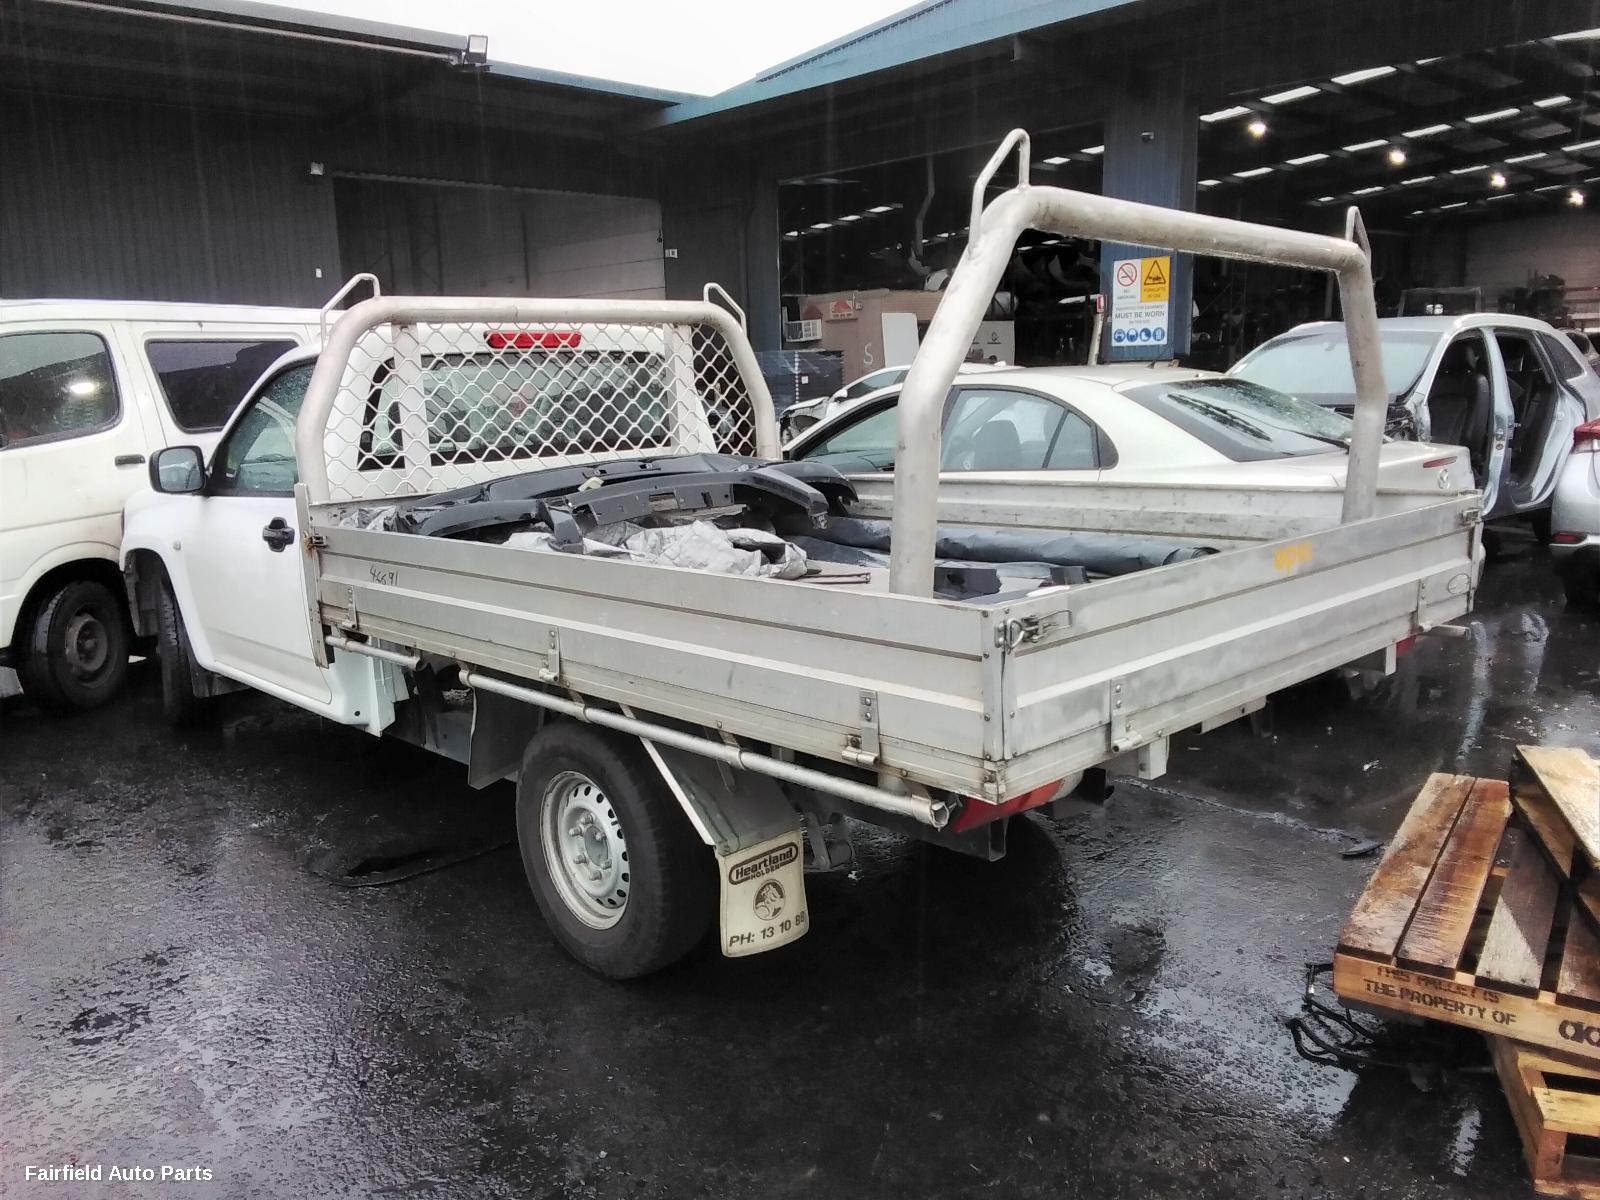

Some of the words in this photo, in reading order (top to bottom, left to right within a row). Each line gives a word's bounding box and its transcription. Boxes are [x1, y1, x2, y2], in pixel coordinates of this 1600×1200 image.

[1114, 312, 1133, 320] MUST
[1144, 310, 1165, 318] WORN
[735, 847, 793, 880] Heartland
[750, 865, 780, 880] HOLDEN
[729, 932, 755, 947] PH:
[761, 926, 775, 940] 13
[779, 920, 792, 934] 10
[1363, 979, 1397, 998] THE
[1399, 987, 1486, 1020] PROPERTY
[1492, 1010, 1517, 1026] OF
[1484, 989, 1500, 1004] IS
